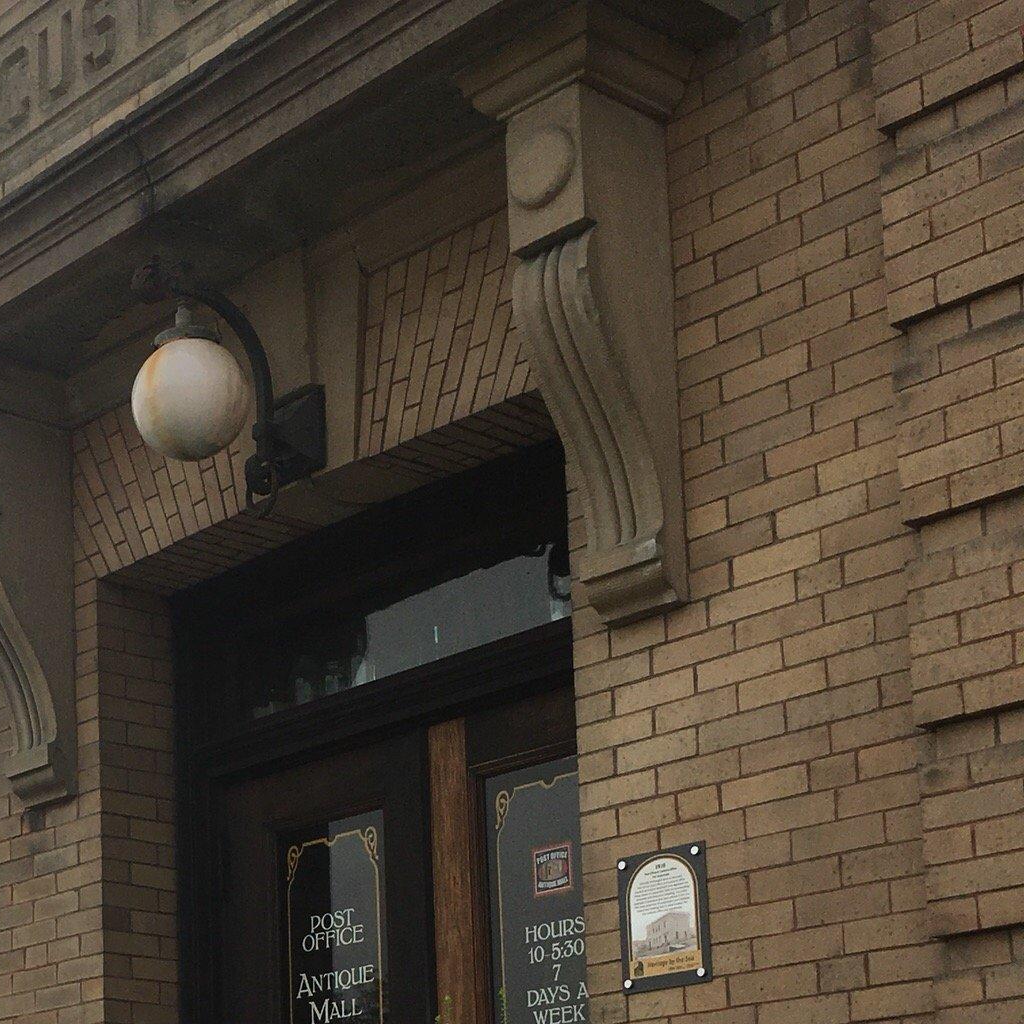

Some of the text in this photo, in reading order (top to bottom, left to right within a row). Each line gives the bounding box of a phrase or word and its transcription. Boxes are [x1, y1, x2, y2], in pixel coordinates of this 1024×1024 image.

[310, 908, 355, 934] POST
[525, 916, 586, 944] HOURS
[302, 924, 365, 953] OFFICE
[552, 963, 562, 982] 7
[526, 981, 590, 1008] DAYS A
